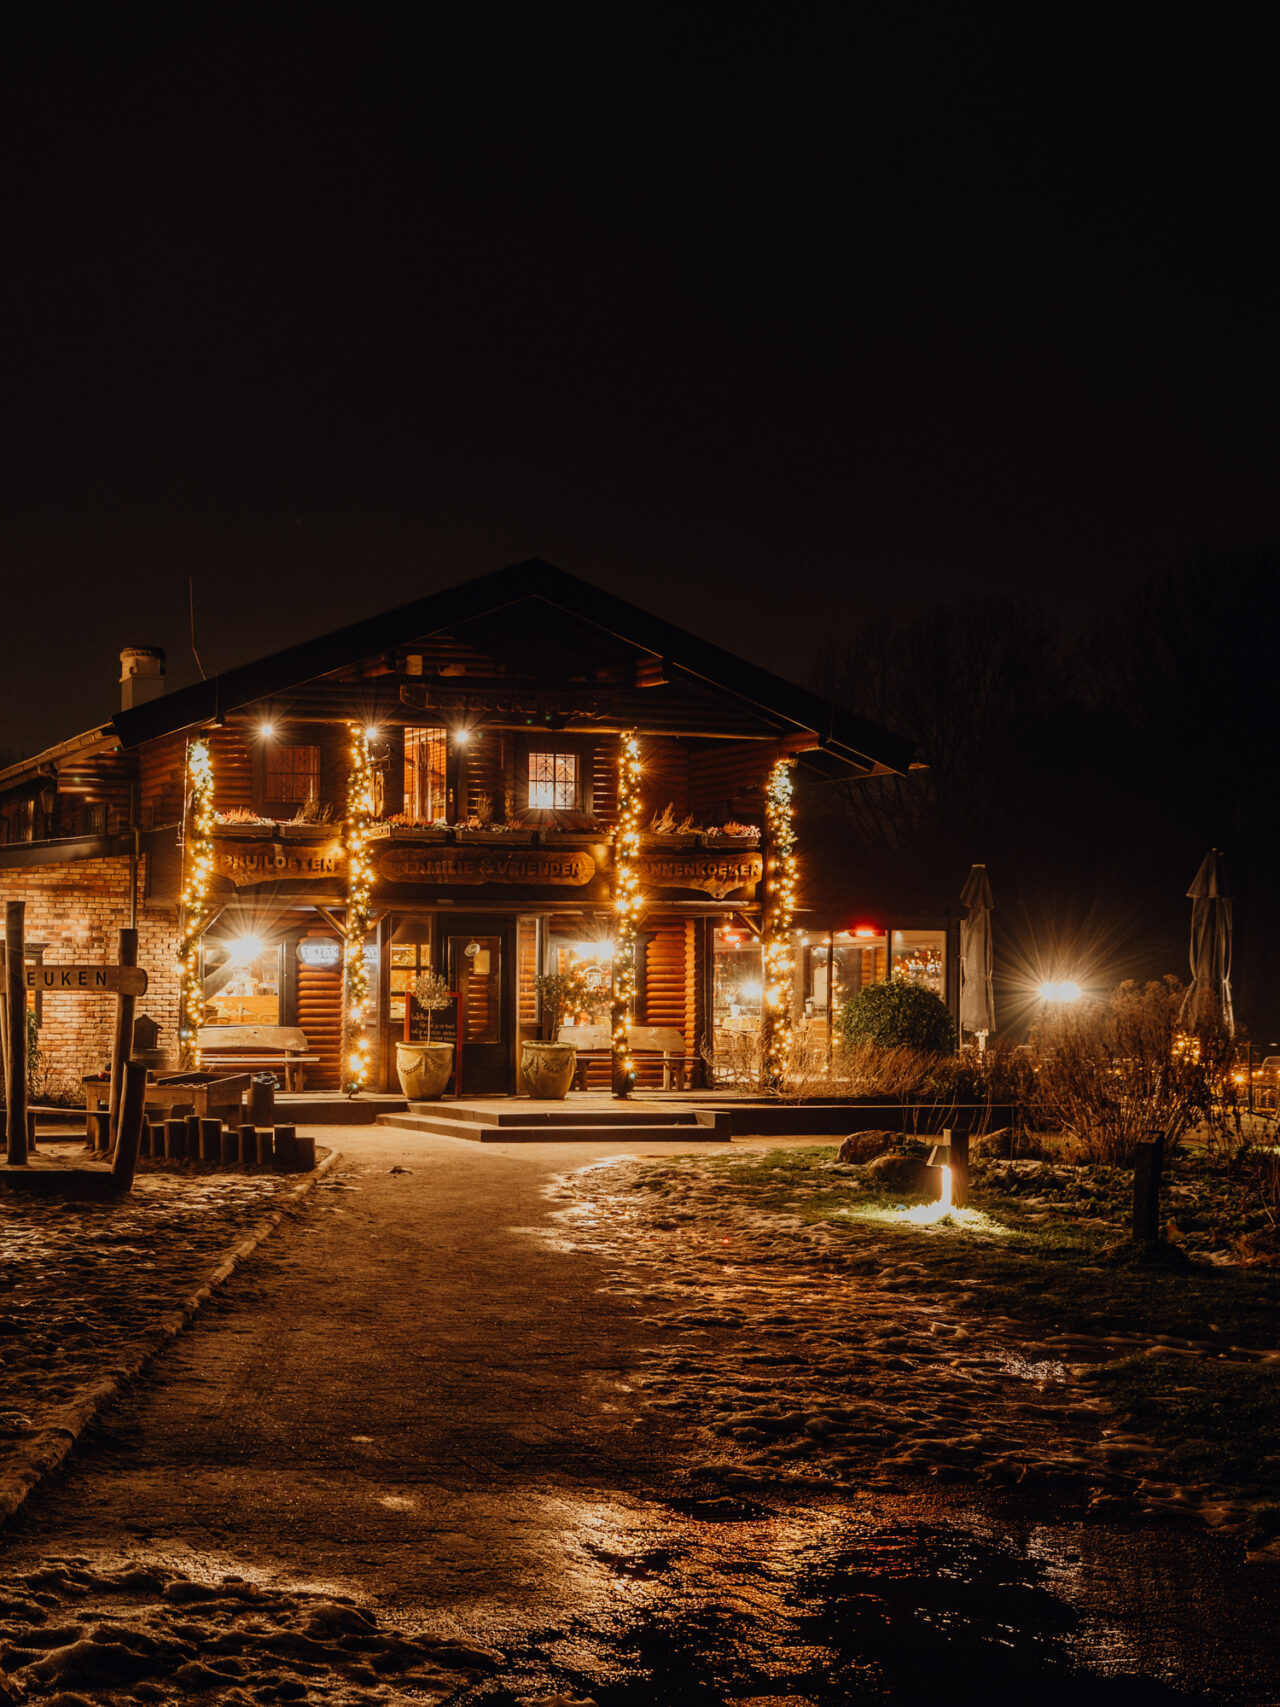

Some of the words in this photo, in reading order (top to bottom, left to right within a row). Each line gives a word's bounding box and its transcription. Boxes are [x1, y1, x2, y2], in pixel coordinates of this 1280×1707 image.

[220, 855, 336, 872] BRUILOFTEN
[496, 860, 582, 877] VRIENDEN
[642, 862, 760, 877] NNENKOEKEN
[26, 971, 107, 987] EUKEN
